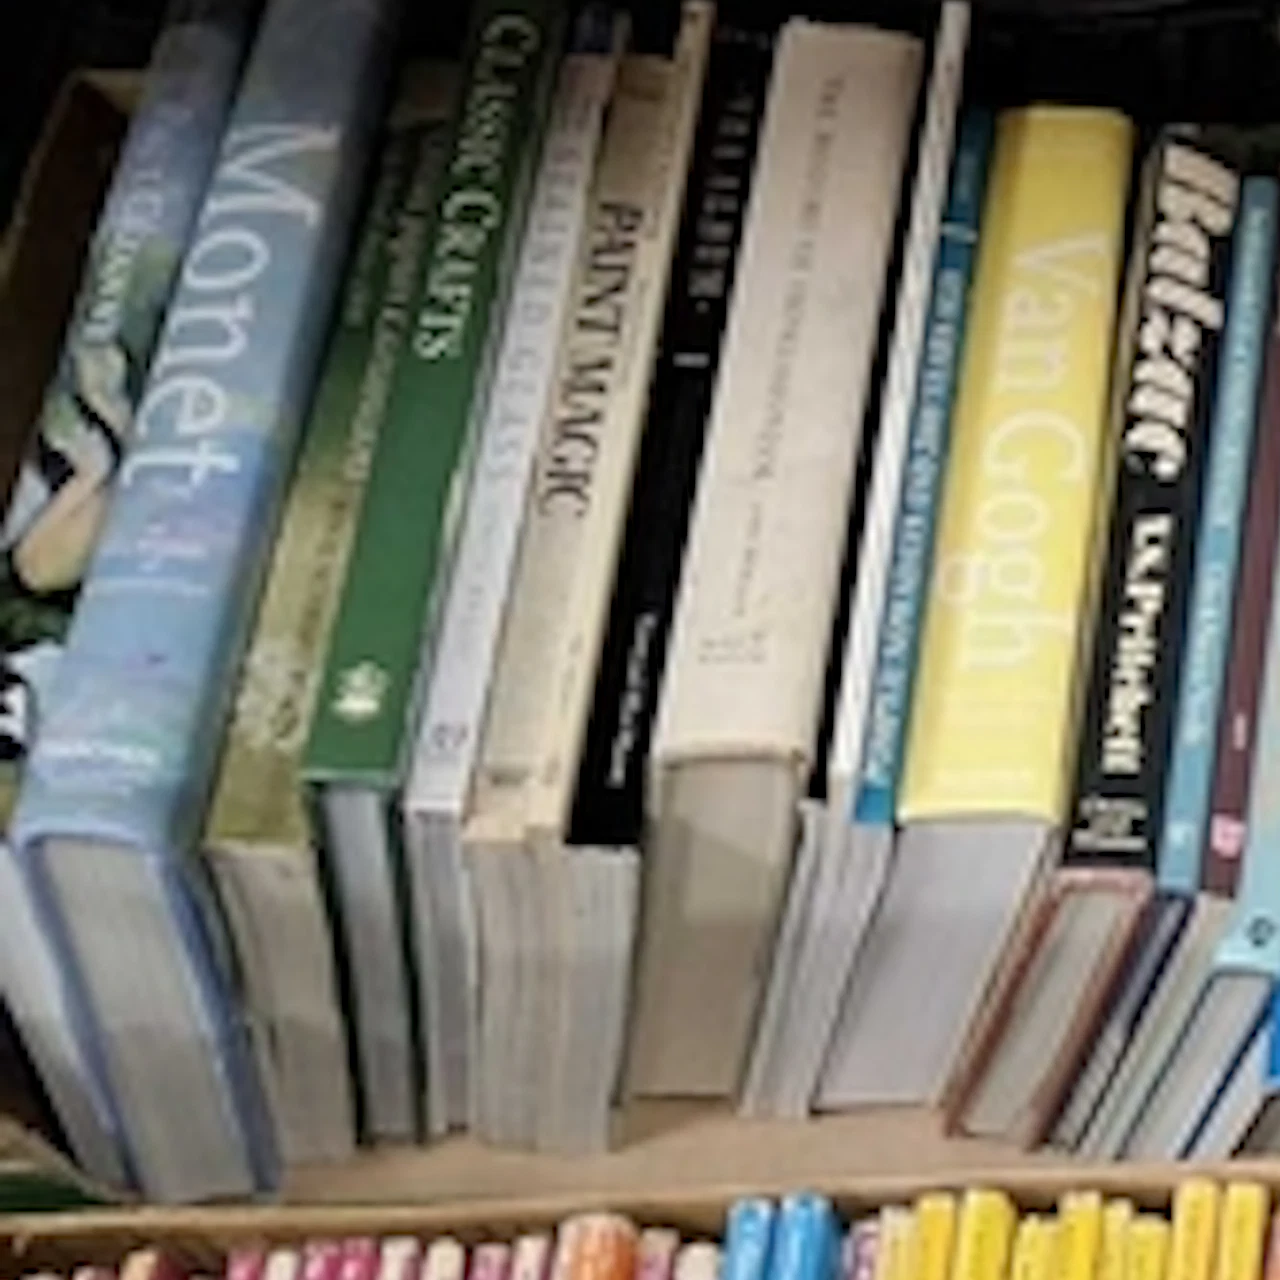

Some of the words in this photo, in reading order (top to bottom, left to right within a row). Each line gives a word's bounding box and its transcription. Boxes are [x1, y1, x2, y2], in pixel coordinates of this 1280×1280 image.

[449, 9, 543, 188] CLASSIC
[120, 122, 340, 490] Monet
[414, 187, 504, 363] CRAFTS
[574, 199, 645, 339] PAINT
[994, 228, 1110, 395] Van
[1118, 144, 1246, 488] Balzac
[537, 350, 617, 525] MAGIC
[938, 408, 1088, 677] Gogh
